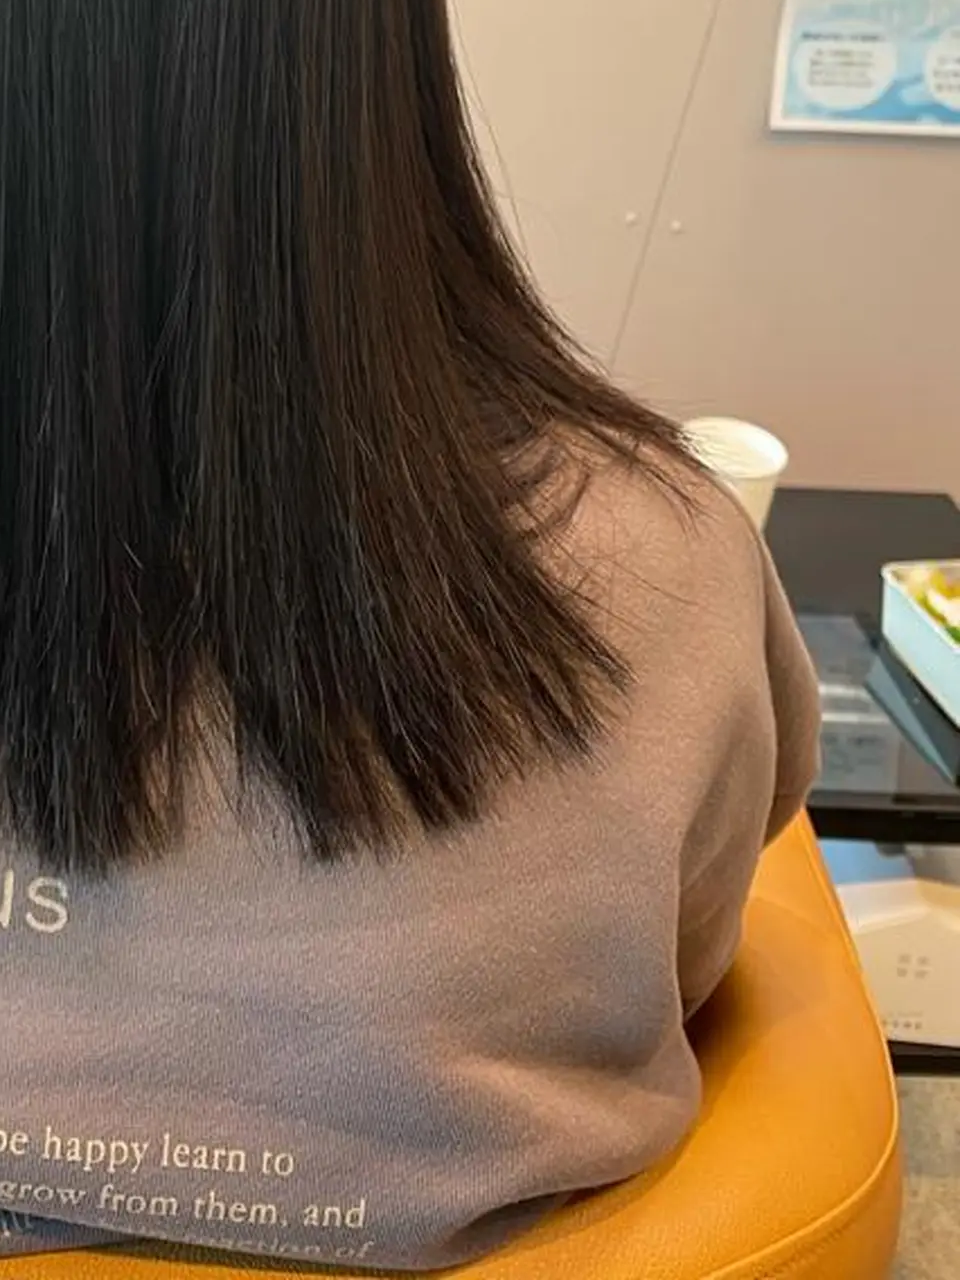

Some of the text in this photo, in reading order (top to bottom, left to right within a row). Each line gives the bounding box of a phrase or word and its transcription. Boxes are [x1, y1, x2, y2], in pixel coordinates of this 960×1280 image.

[41, 1125, 149, 1174] happy
[160, 1133, 247, 1174] learn
[261, 1148, 294, 1176] to
[97, 1184, 180, 1218] from
[194, 1191, 288, 1228] them,
[302, 1197, 367, 1229] and
